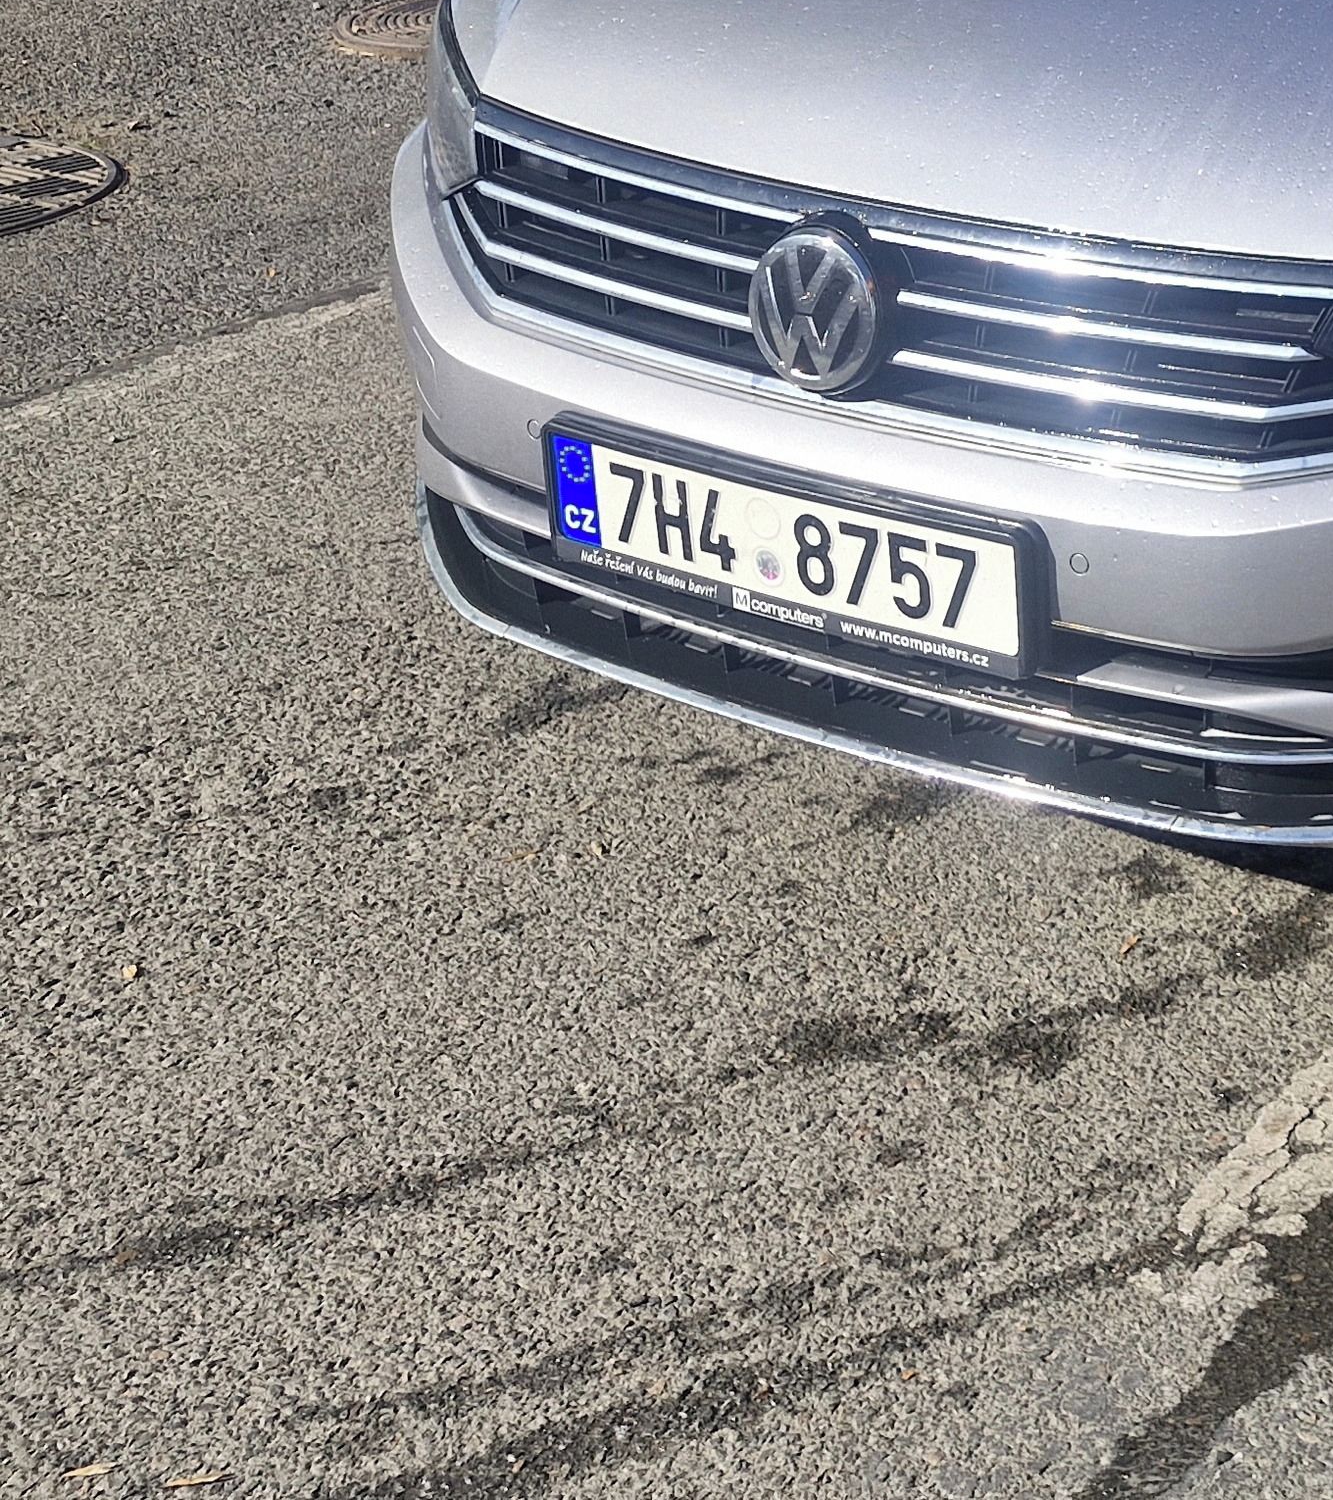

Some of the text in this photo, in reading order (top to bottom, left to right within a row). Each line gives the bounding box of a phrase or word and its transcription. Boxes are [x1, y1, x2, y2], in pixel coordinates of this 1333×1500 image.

[564, 504, 597, 533] CZ
[609, 462, 977, 629] 7H4 8757
[580, 549, 604, 566] Naše
[604, 552, 634, 576] řešení
[656, 568, 686, 591] budou
[688, 579, 719, 599] bavit!
[839, 620, 990, 668] www.mcomputers.cz
